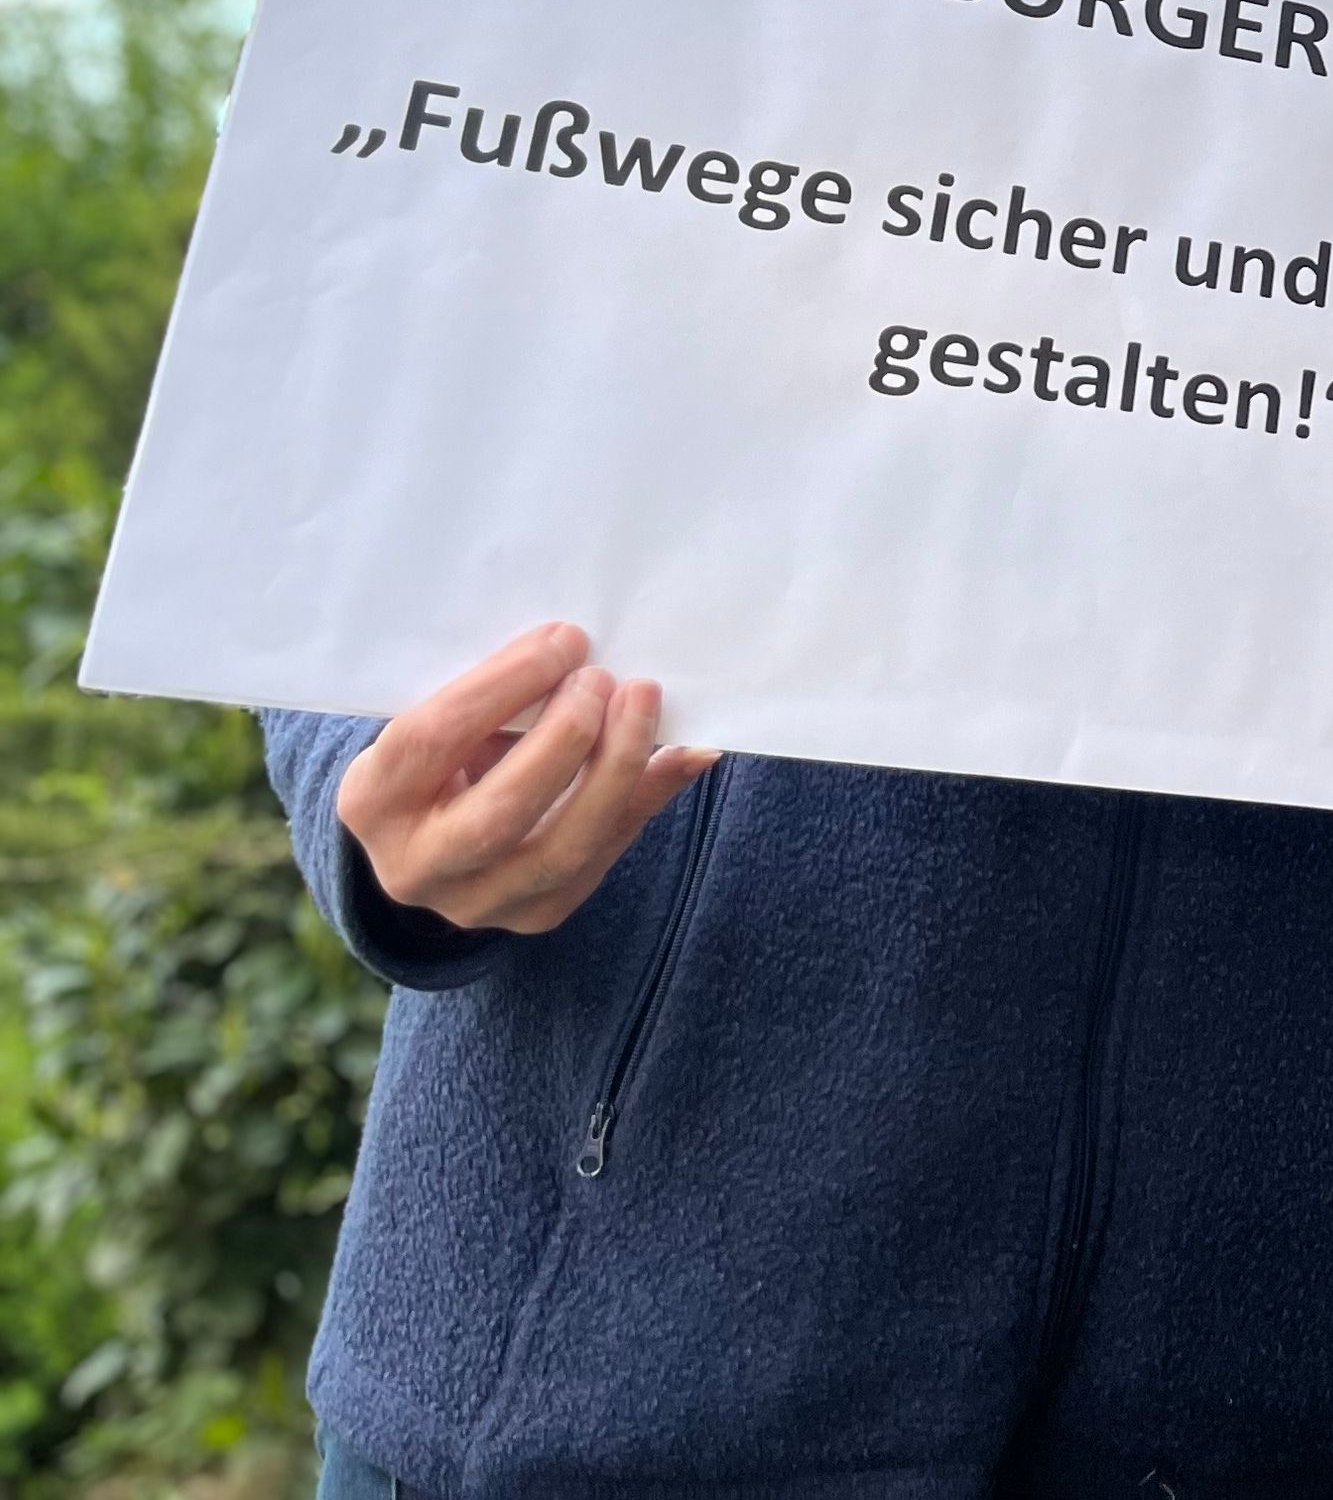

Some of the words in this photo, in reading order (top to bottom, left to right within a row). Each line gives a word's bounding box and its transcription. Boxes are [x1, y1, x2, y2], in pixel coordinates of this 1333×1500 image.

[332, 81, 851, 230] „Fußwege
[883, 172, 1147, 274] sicher
[1176, 237, 1331, 308] und
